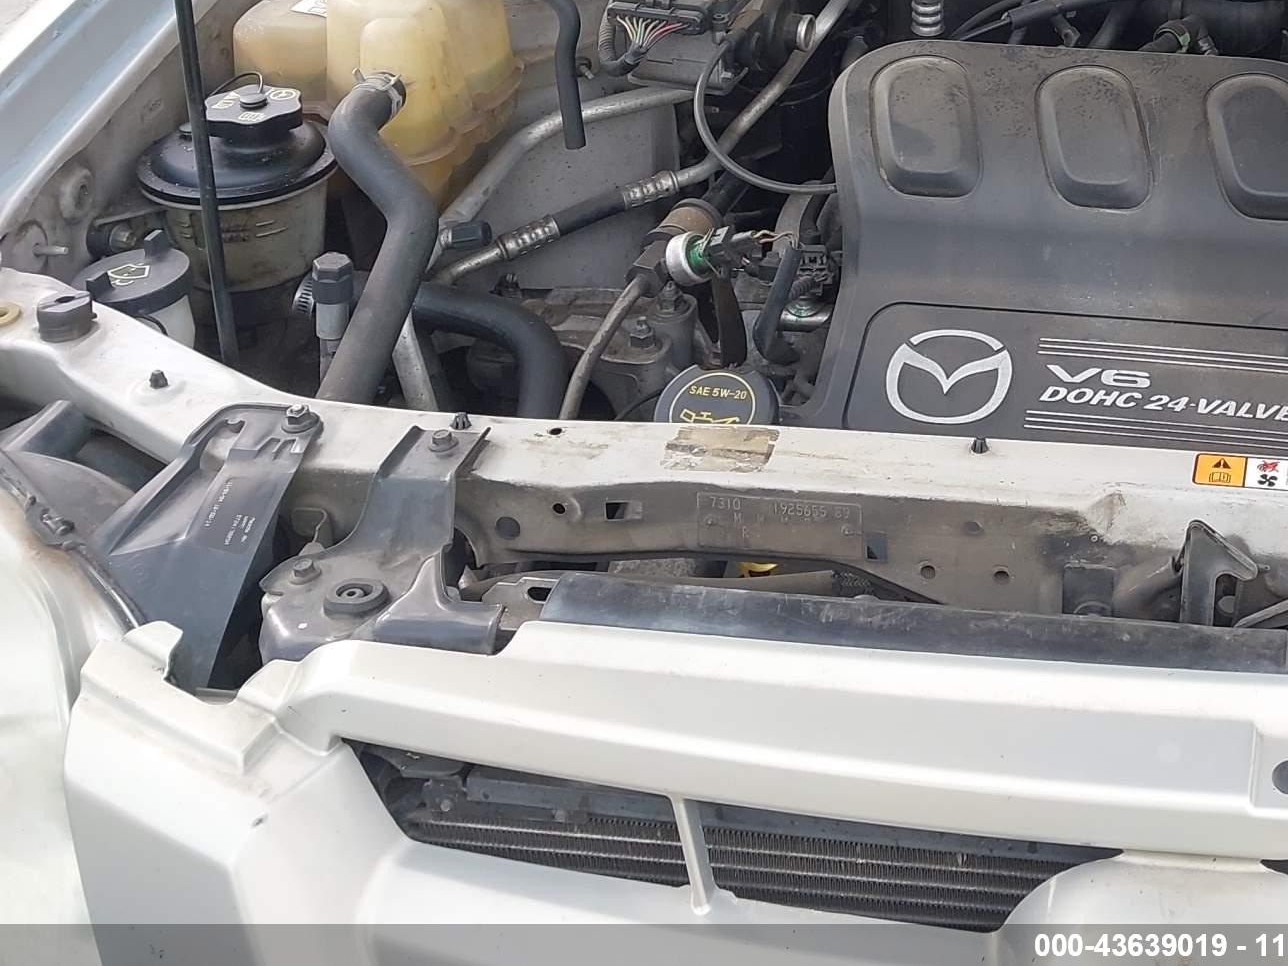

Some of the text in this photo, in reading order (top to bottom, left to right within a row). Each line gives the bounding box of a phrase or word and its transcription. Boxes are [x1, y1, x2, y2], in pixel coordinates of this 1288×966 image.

[1046, 364, 1152, 389] V6
[689, 385, 747, 400] SAE 5W-20
[1039, 386, 1142, 409] DOHC
